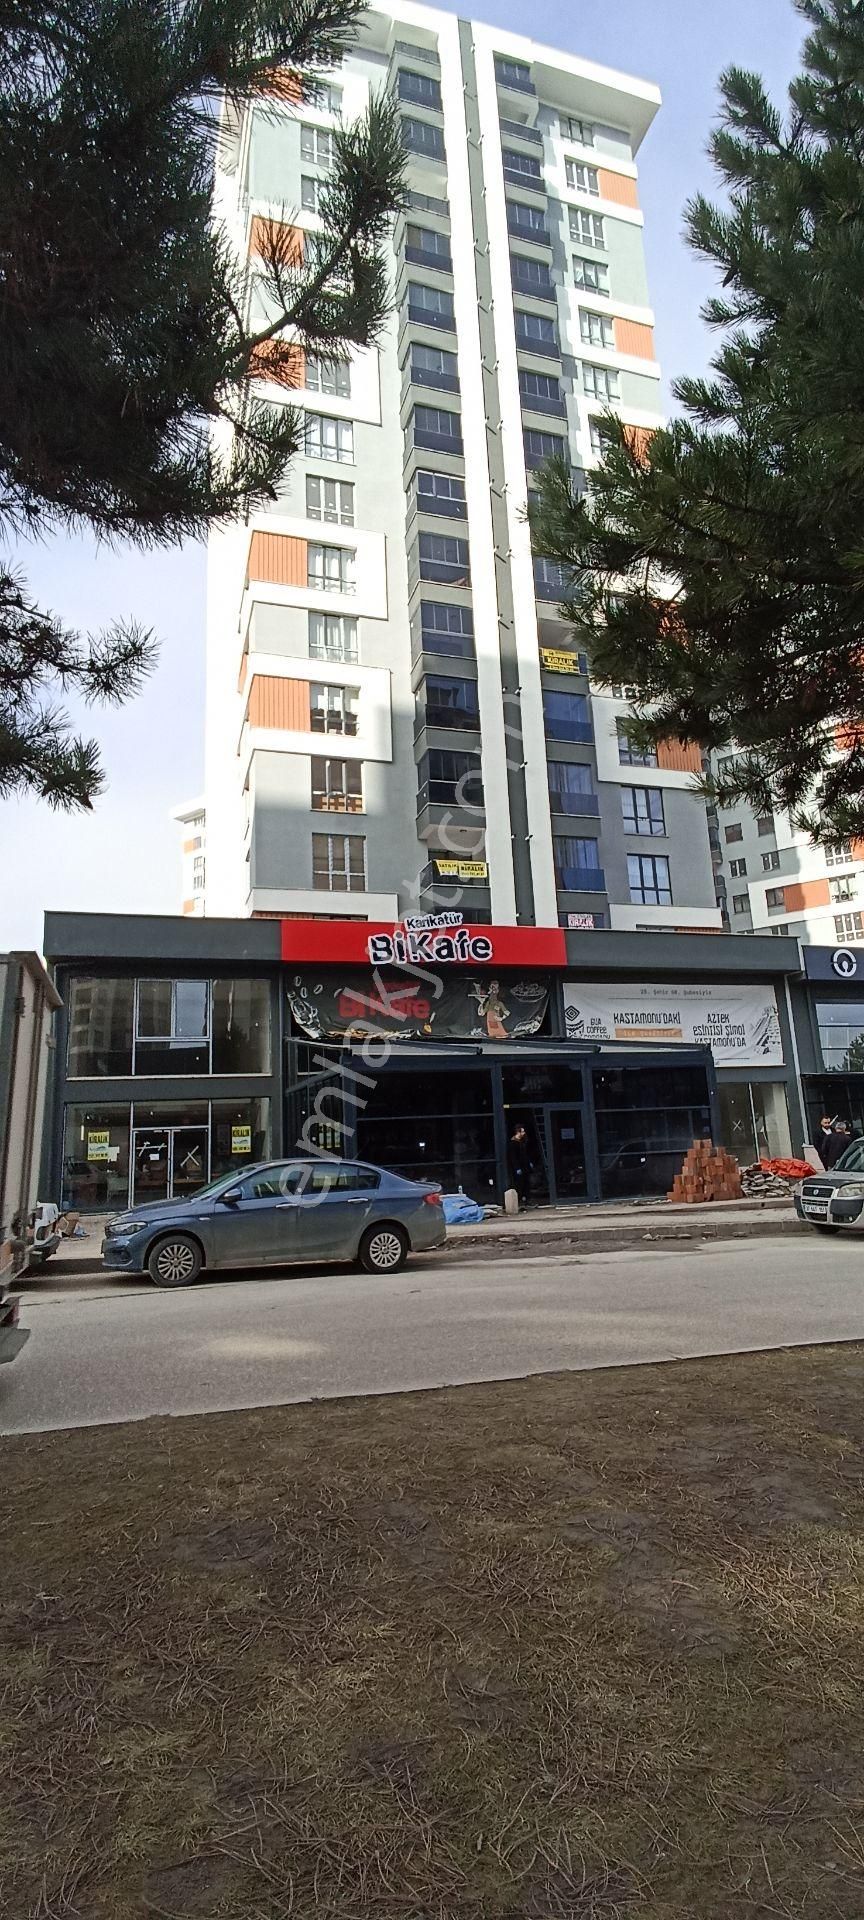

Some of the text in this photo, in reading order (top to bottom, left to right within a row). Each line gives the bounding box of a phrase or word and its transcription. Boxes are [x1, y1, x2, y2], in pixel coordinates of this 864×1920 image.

[404, 912, 463, 932] Karikatür
[369, 929, 492, 964] BiKafe
[707, 1013, 730, 1024] AZTEK
